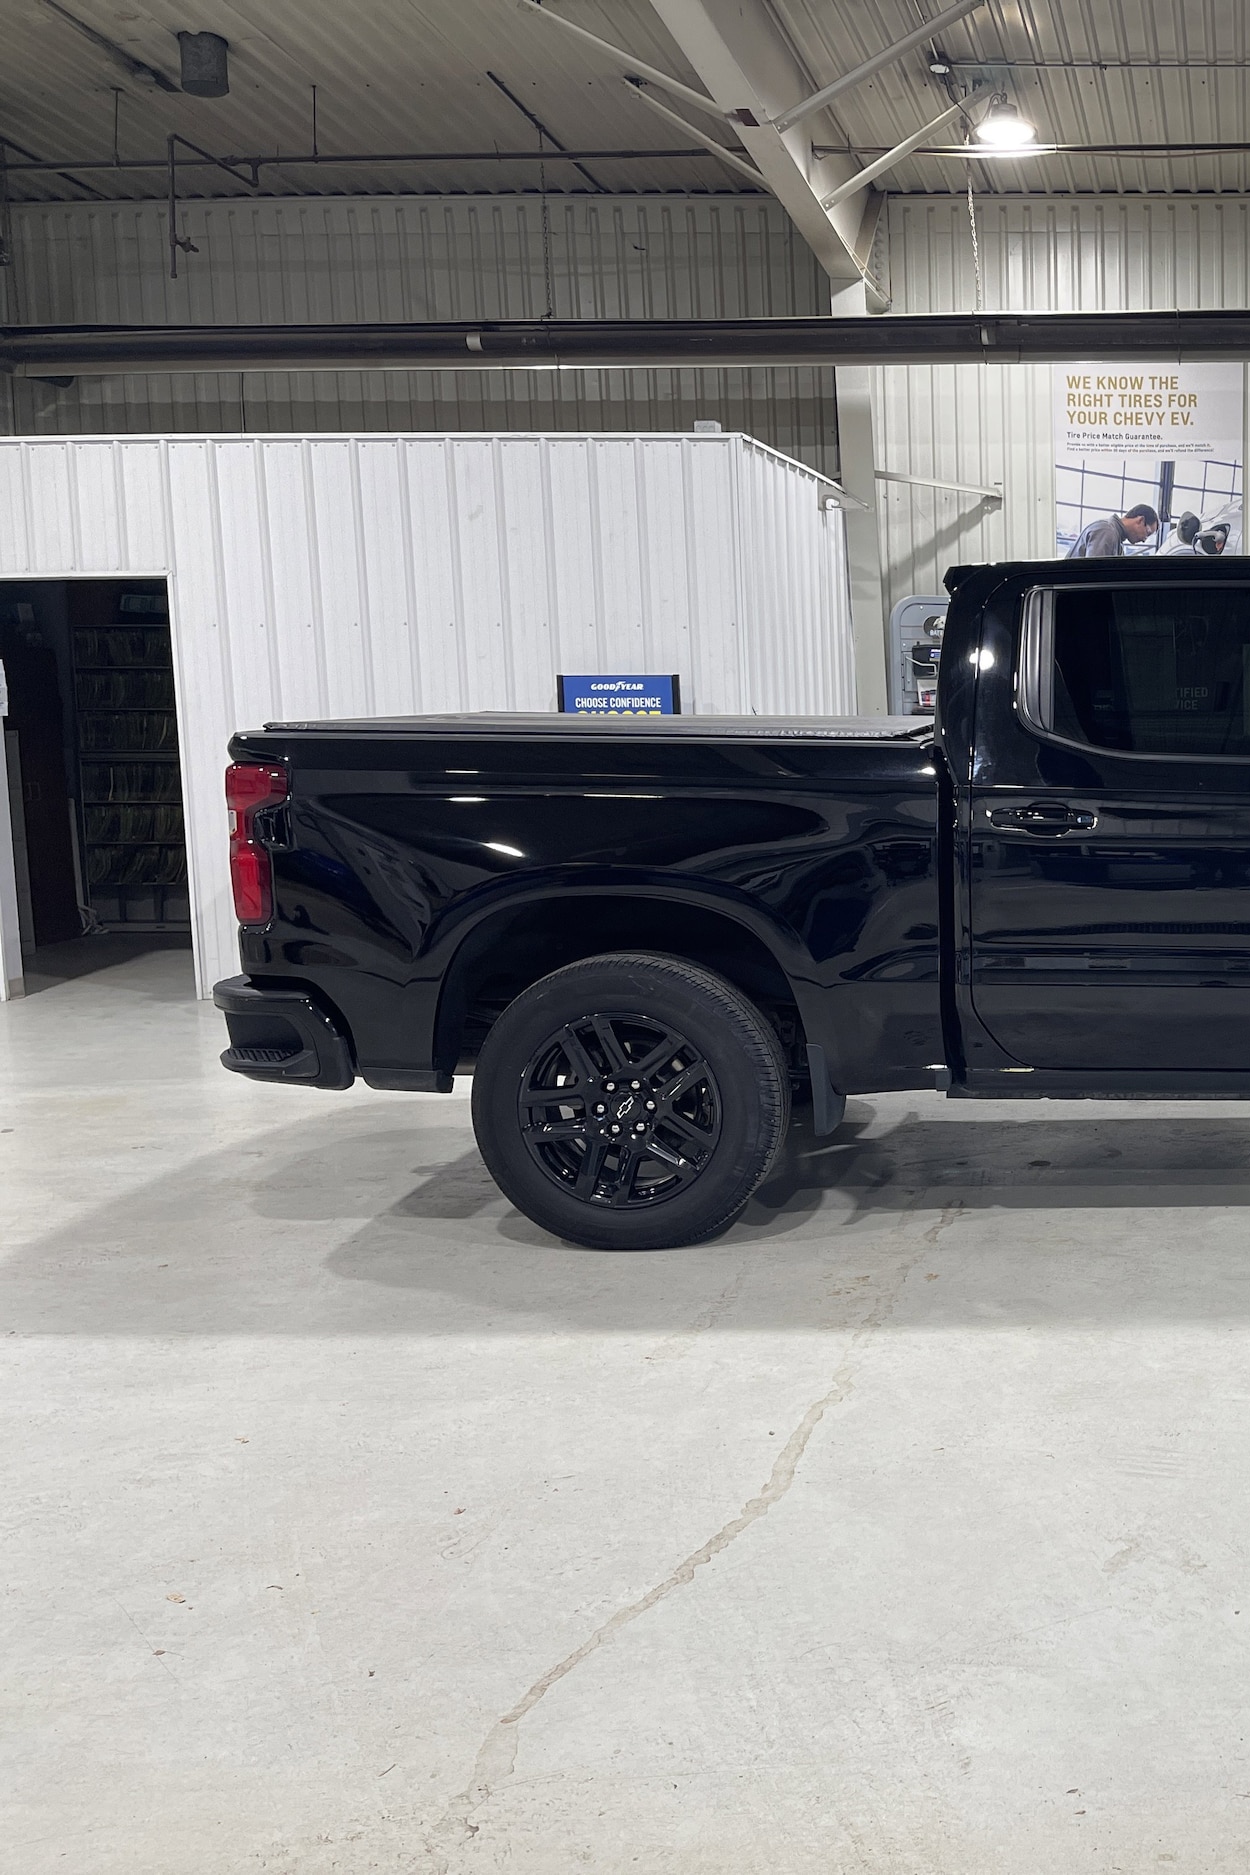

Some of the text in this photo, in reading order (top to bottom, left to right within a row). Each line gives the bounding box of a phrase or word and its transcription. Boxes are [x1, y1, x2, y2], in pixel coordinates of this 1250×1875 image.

[1066, 376, 1178, 390] WE KNOW THE
[1067, 394, 1197, 407] RIGHT TIRES FOR
[1067, 411, 1194, 425] YOUR CHEVY EV.
[591, 681, 644, 692] GOODYEAR
[575, 698, 661, 708] CHOOSE CONFIDENCE
